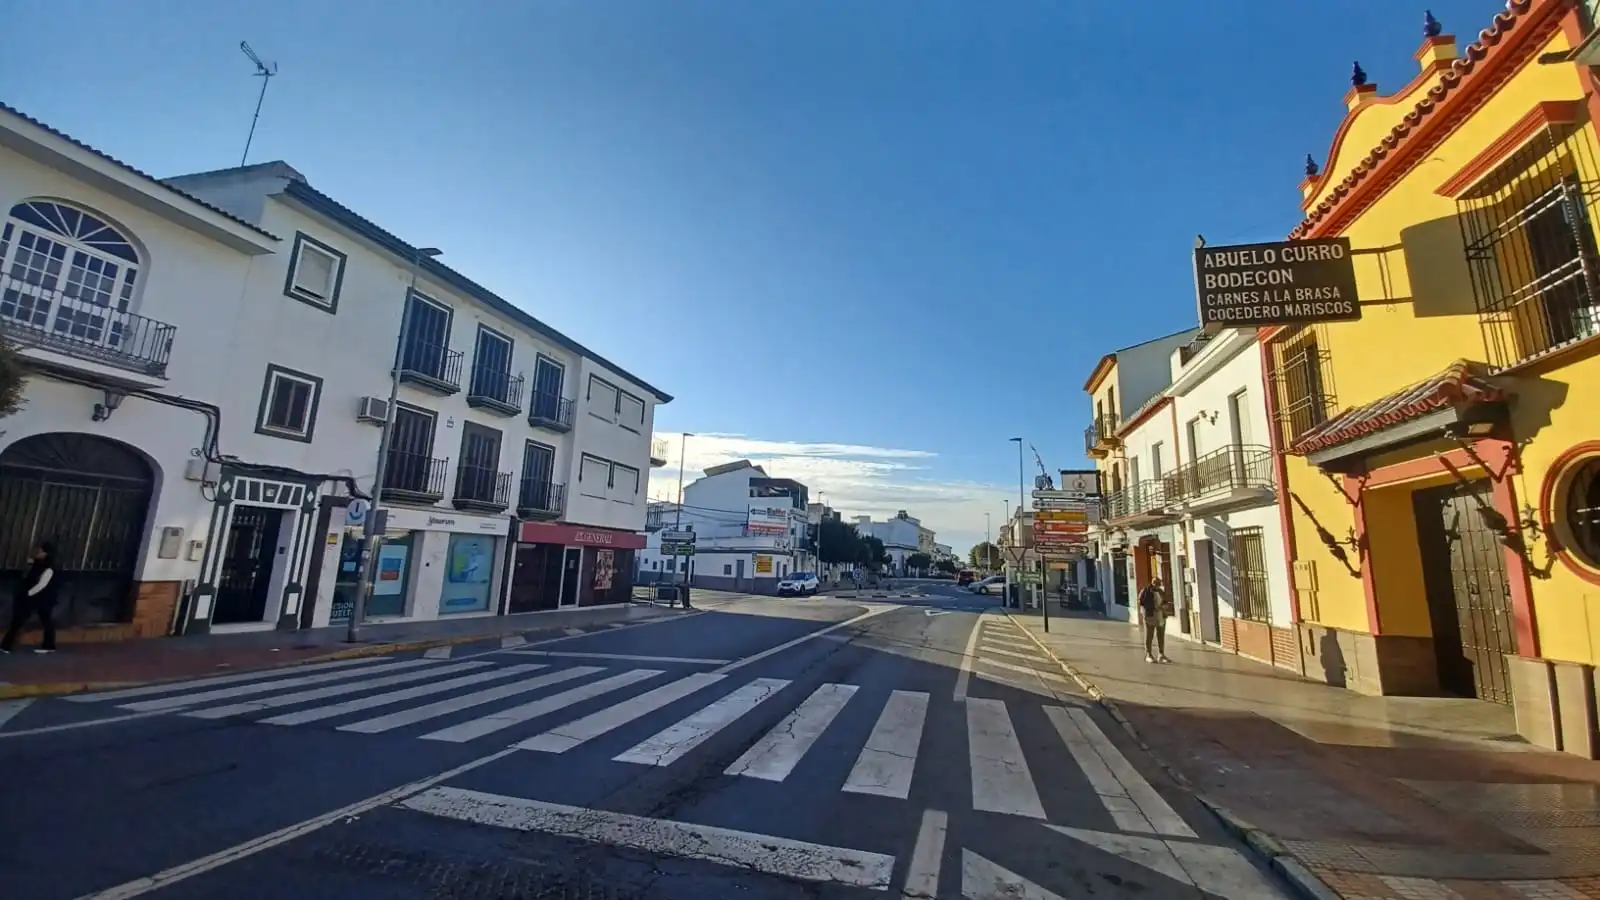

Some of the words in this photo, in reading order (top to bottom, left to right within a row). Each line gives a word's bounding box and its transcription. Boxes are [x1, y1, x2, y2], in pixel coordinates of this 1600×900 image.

[1204, 249, 1276, 268] ABUELO
[1281, 244, 1344, 263] CURRO
[1207, 291, 1259, 306] CARNES
[1263, 290, 1271, 303] A
[1273, 289, 1291, 302] LA
[1295, 286, 1341, 301] BRASA
[1208, 305, 1280, 321] COCEDERO
[1285, 300, 1353, 317] MARISCOS
